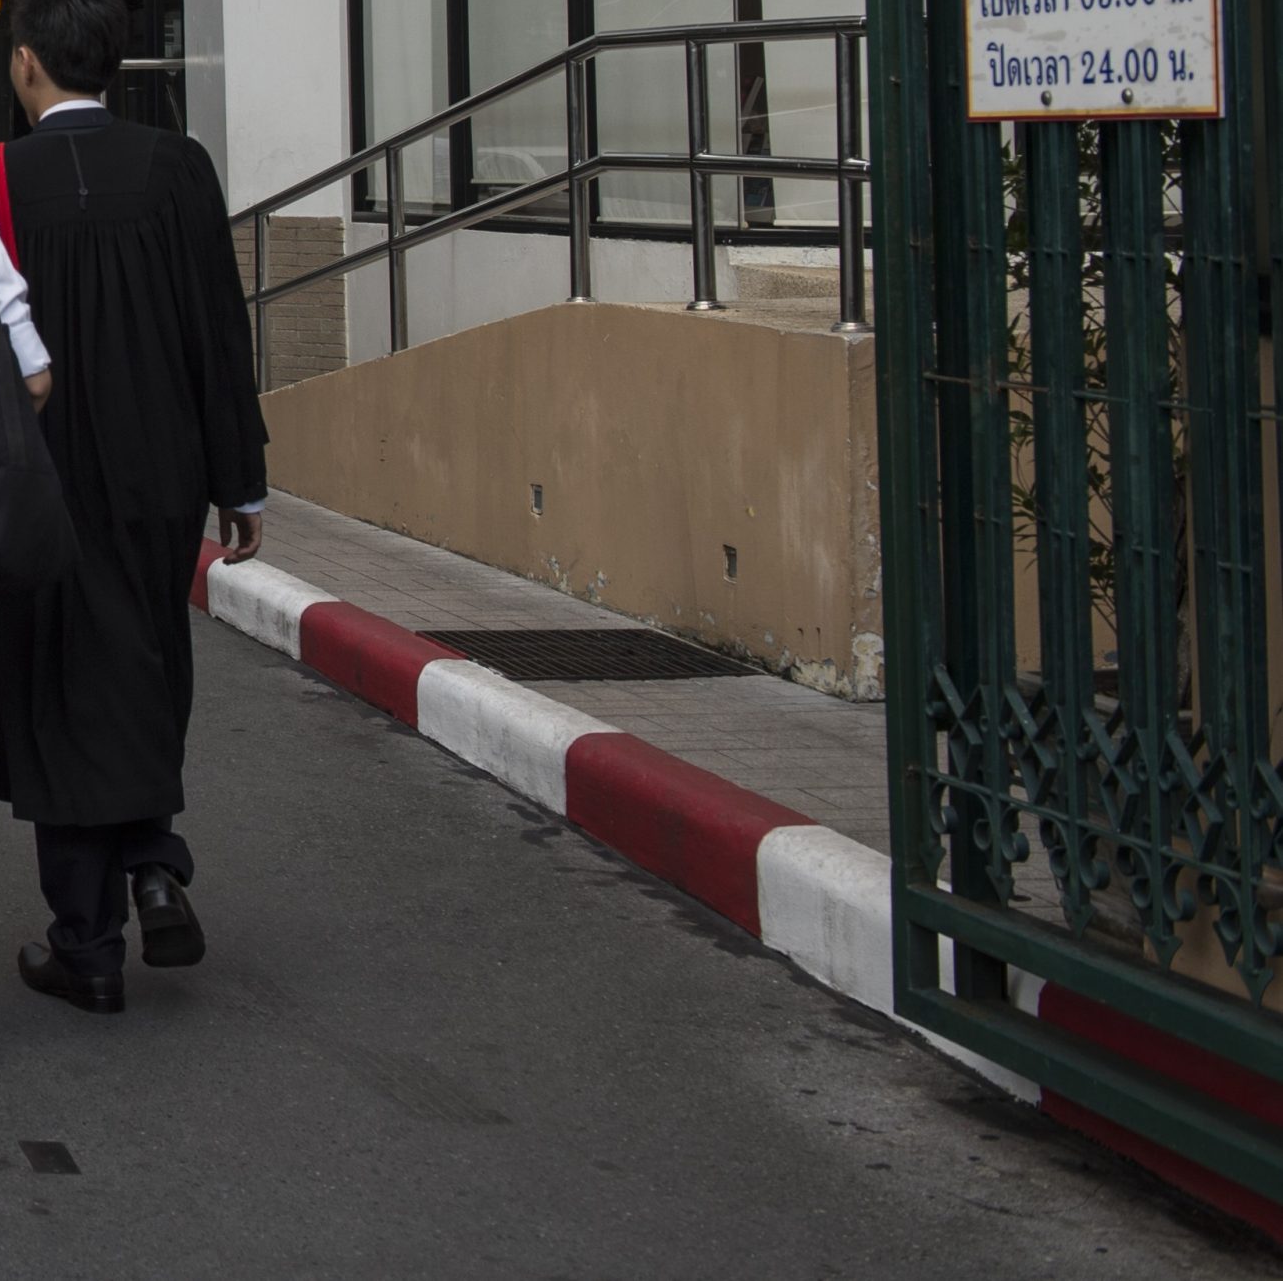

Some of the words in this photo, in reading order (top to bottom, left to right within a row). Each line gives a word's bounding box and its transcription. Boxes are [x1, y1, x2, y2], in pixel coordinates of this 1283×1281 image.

[986, 42, 1071, 88] ปิดเวลา
[1080, 47, 1159, 85] 24.00
[1169, 48, 1194, 81] น.
